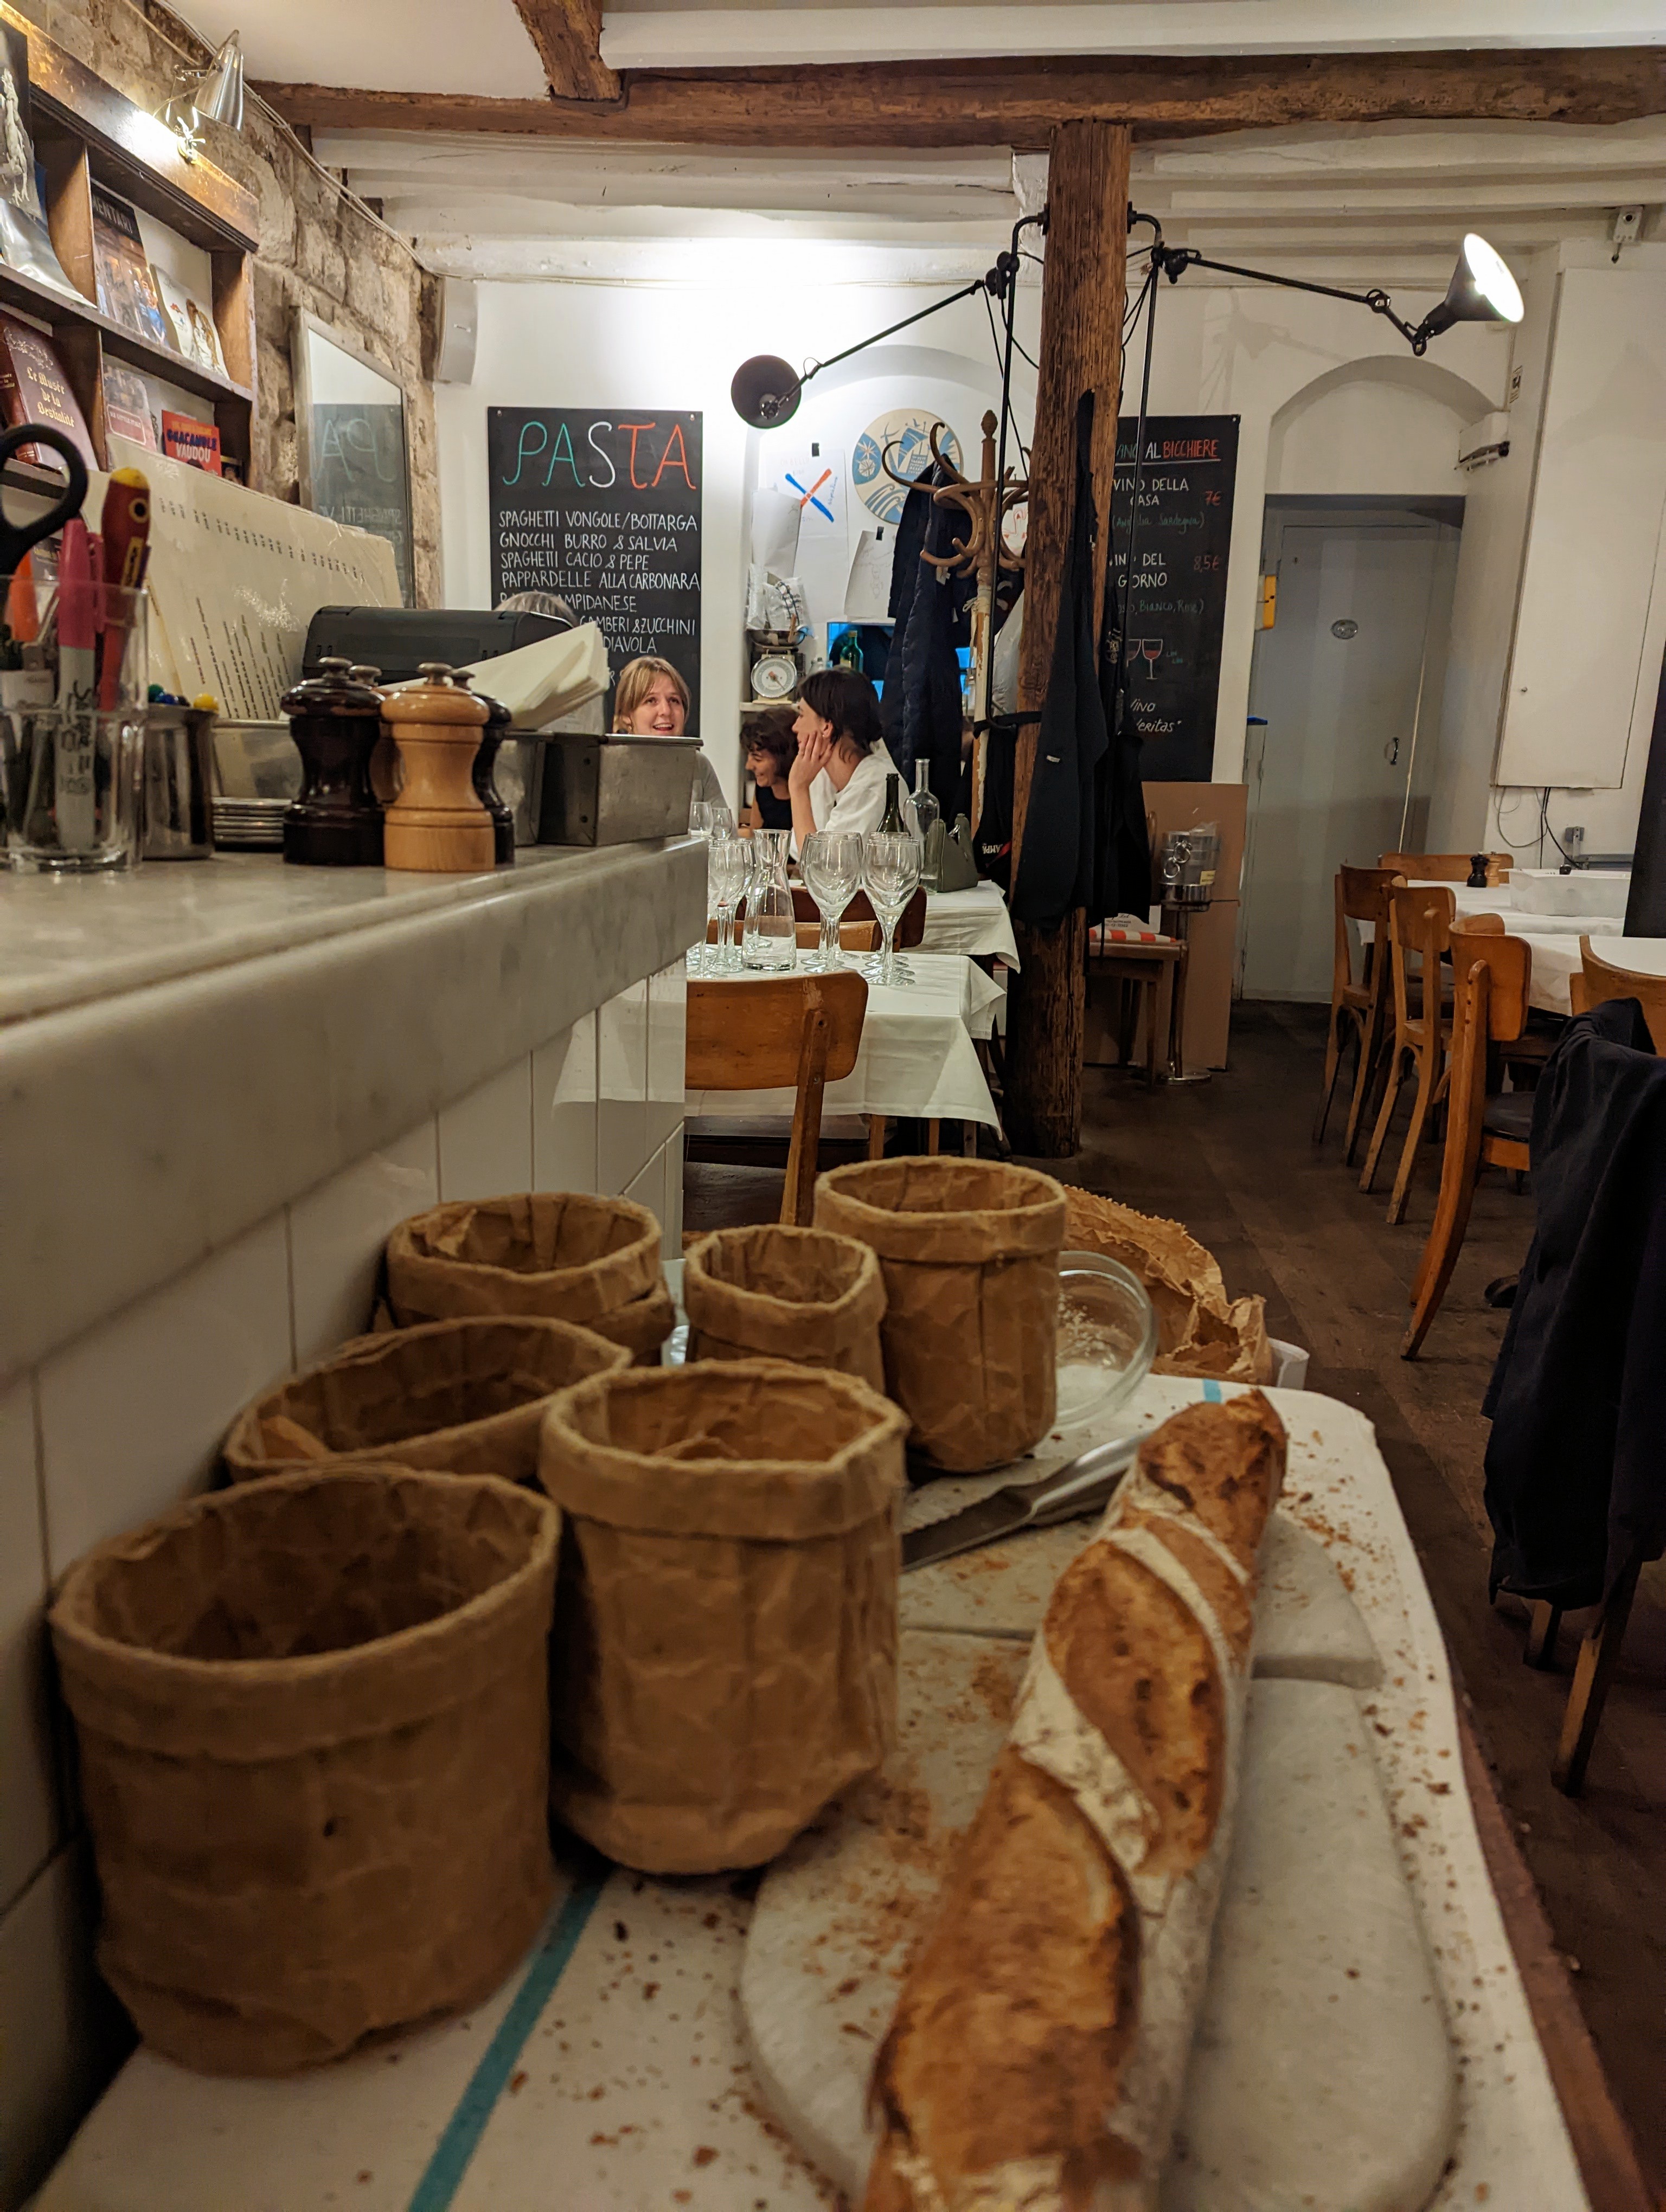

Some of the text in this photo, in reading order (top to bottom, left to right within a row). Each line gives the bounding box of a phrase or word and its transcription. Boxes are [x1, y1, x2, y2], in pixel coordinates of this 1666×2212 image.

[27, 366, 37, 382] Le
[41, 388, 61, 408] de la
[176, 442, 211, 464] VAUDOU
[503, 421, 696, 490] PASTA
[1145, 441, 1162, 459] AL
[1163, 439, 1220, 459] BICCHIERE
[1152, 478, 1190, 492] DELLA
[498, 510, 698, 531] SPAGHETTI VONGOLE/BOTTARGA
[499, 532, 678, 552] GNOCCHI BURRO & SALVIA
[501, 550, 650, 570] SPAGHETTI CACIO & PEPE
[1143, 552, 1166, 566] DEL
[502, 570, 591, 589] PAPPARDELLE
[629, 573, 701, 591] CARBONARA
[1118, 572, 1167, 589] GORNO
[604, 636, 657, 654] DIAVOLA
